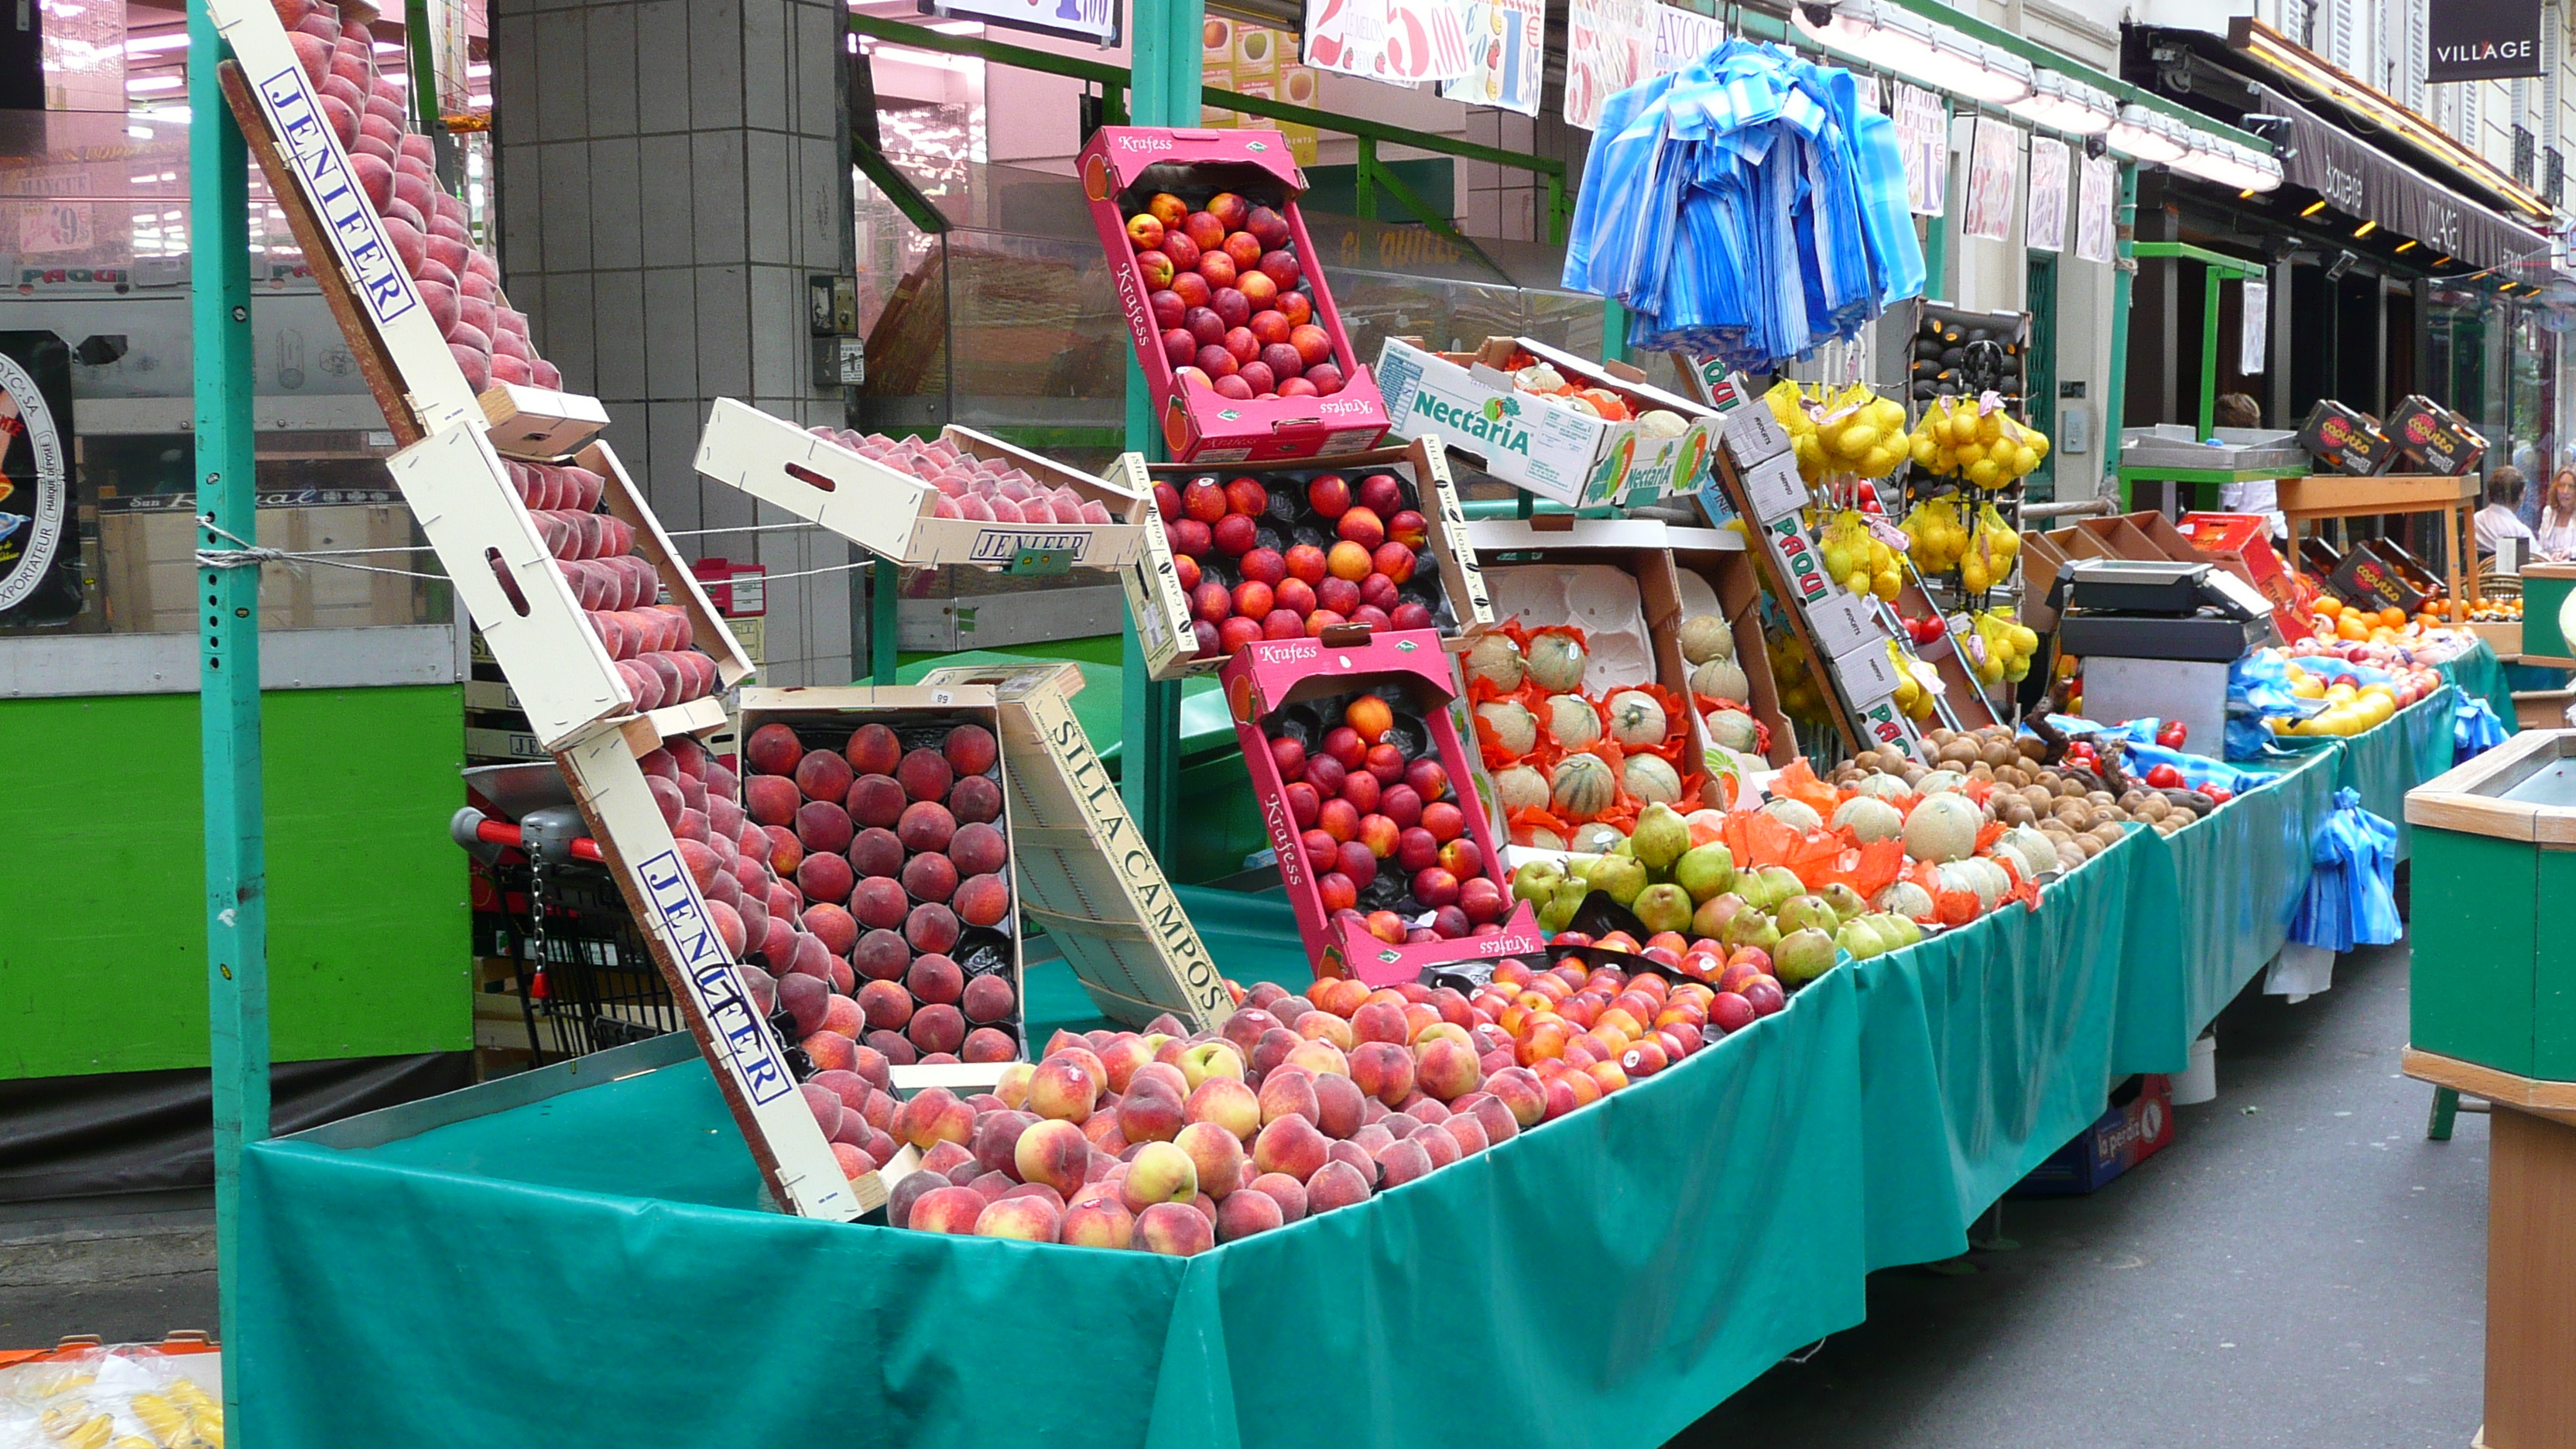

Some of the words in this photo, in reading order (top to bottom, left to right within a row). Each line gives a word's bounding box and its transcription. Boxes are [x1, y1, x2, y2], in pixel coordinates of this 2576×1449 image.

[2437, 40, 2531, 62] VILLAGE
[1118, 135, 1173, 153] Krafess
[272, 86, 402, 311] JENIFER
[22, 269, 127, 284] PAQUI
[1117, 262, 1149, 346] Krafess
[1698, 355, 1740, 412] QUI
[1320, 399, 1374, 417] Krafess
[1412, 390, 1530, 457] NectariA
[1753, 416, 1772, 446] AVOCATS
[2323, 420, 2370, 455] caputto
[2408, 417, 2454, 455] caputto
[1625, 461, 1672, 488] NectariA
[1778, 471, 1793, 496] MANGO
[130, 496, 159, 508] Sun
[1773, 516, 1828, 603] PAQUI
[2356, 564, 2399, 602] caputto
[1844, 607, 1862, 636] AVOCATS
[1260, 644, 1317, 663] Krafess
[1869, 658, 1885, 682] MANGO
[1869, 703, 1917, 764] PAQ
[1264, 793, 1302, 886] Krafess
[1052, 720, 1124, 843] SILLA
[1125, 849, 1225, 1012] CAMPOS
[1479, 935, 1535, 956] Krafess
[649, 871, 777, 1094] JENIFER
